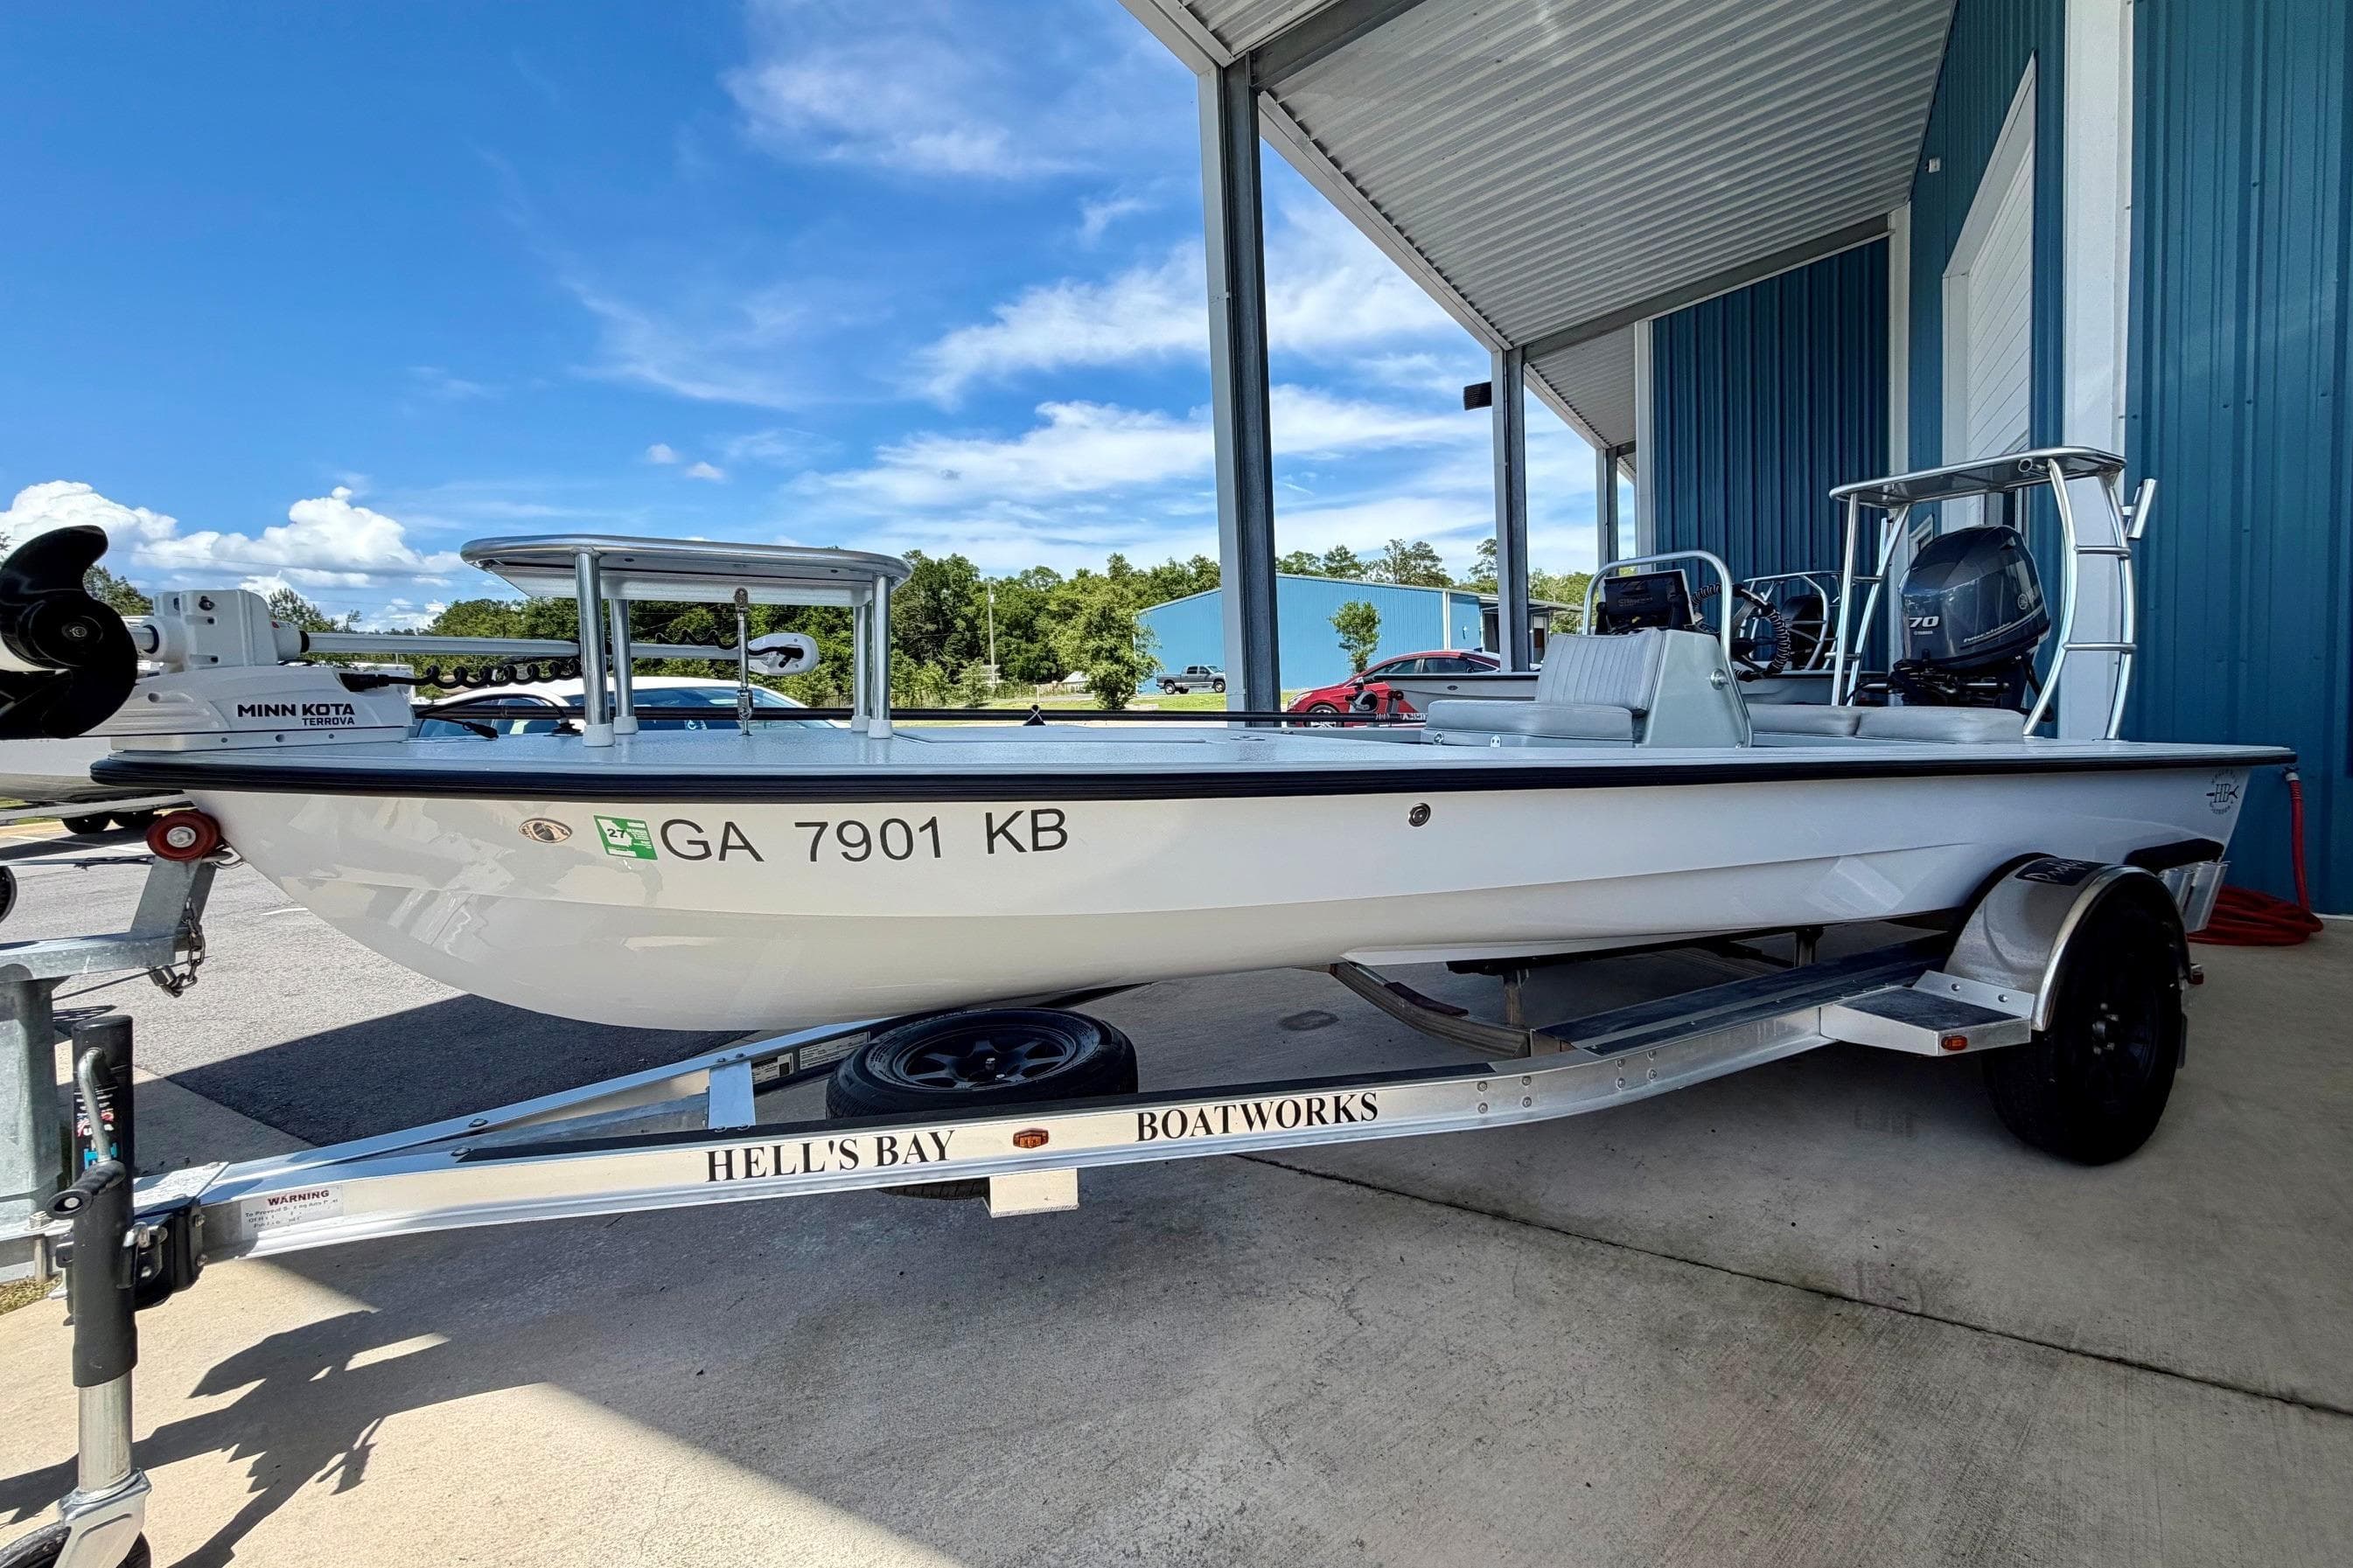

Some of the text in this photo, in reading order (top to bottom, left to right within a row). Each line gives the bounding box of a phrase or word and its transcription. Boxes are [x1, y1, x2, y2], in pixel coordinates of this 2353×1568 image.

[1909, 616, 1939, 628] 70
[237, 703, 355, 717] MINN KOTA
[302, 717, 355, 726] TERROVA
[607, 828, 625, 839] 27
[660, 819, 765, 862] GA
[794, 816, 941, 862] 7901
[984, 808, 1068, 854] KB
[704, 1091, 1379, 1182] HELL'S BAY BOATWORKS
[268, 1189, 330, 1207] WARNING
